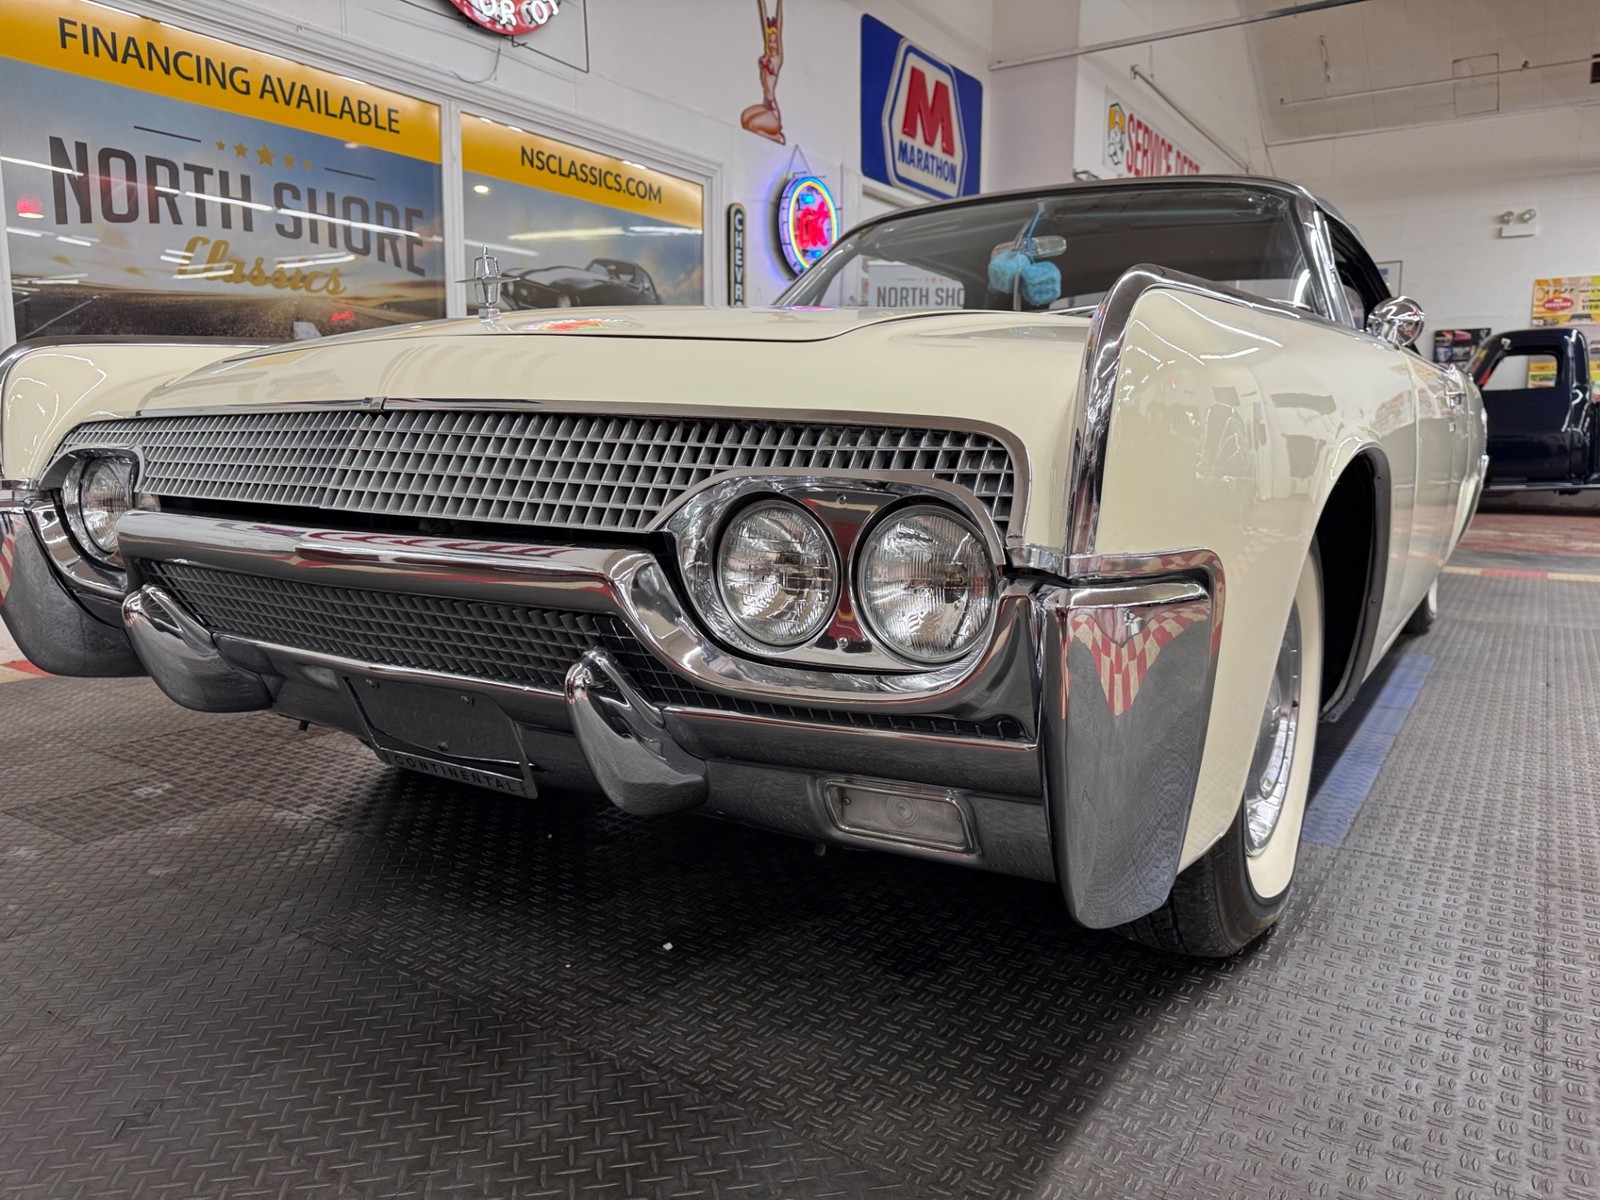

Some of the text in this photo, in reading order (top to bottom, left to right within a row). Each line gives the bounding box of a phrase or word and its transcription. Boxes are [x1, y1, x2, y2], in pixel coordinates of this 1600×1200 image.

[58, 16, 401, 134] FINANCING AVAILABLE
[902, 66, 955, 158] M
[520, 145, 662, 205] NSCLASSICS.COM
[898, 139, 958, 185] MARATHON
[49, 135, 426, 278] NORTH SHORE
[176, 235, 347, 296] Classics
[876, 286, 929, 308] NORTH
[394, 754, 516, 793] CONTINENTAL
